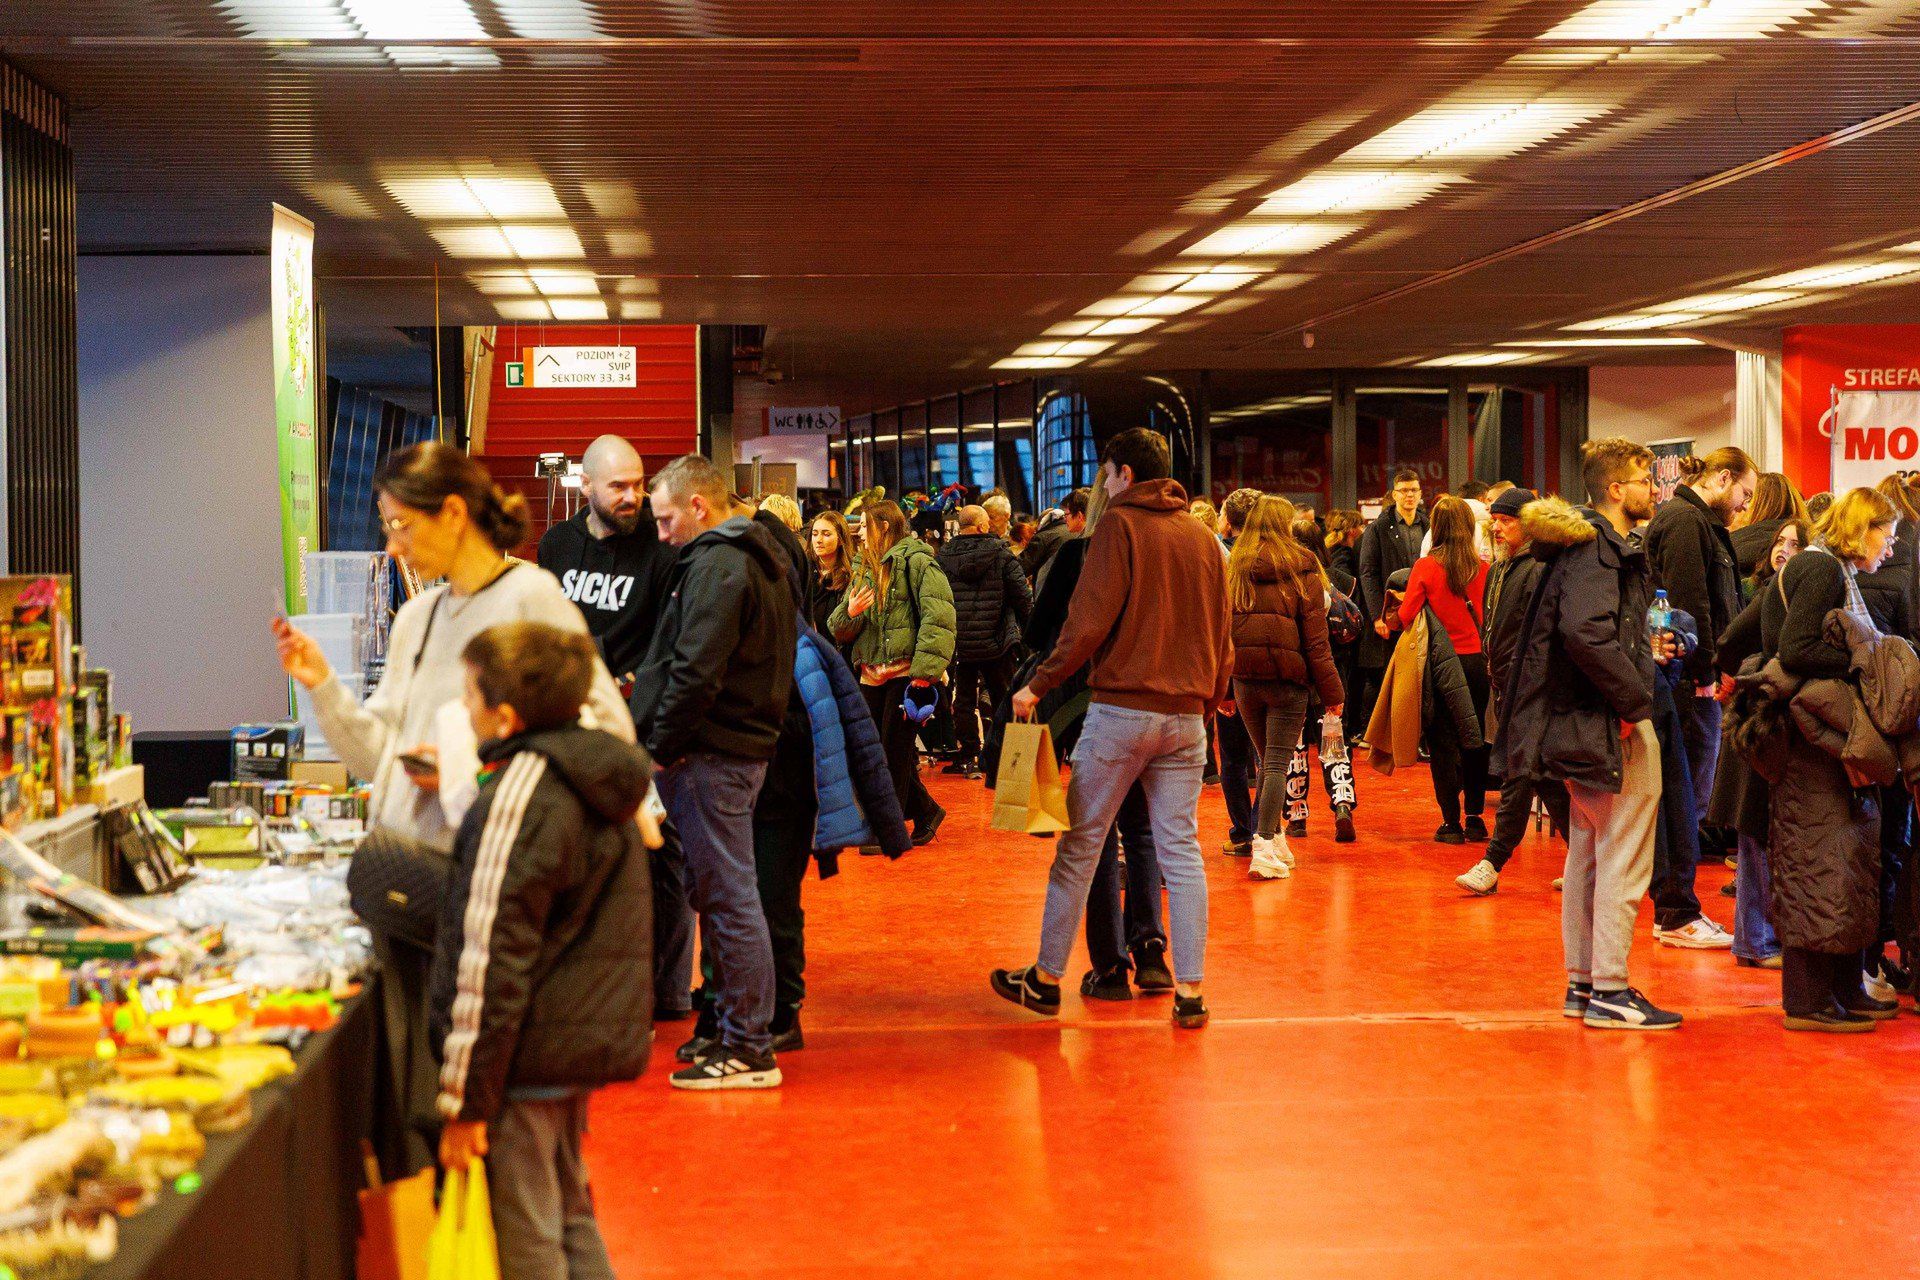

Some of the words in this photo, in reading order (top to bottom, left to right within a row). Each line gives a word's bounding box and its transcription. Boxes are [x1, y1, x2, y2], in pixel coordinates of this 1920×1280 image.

[576, 351, 615, 360] POZIOM
[618, 351, 631, 360] +2
[608, 362, 631, 371] SVIP
[551, 374, 596, 383] SEKTORY
[600, 373, 615, 384] 33,
[619, 373, 631, 383] 34
[1844, 368, 1920, 387] STREFA
[774, 416, 794, 428] WC
[561, 568, 635, 612] SICK!
